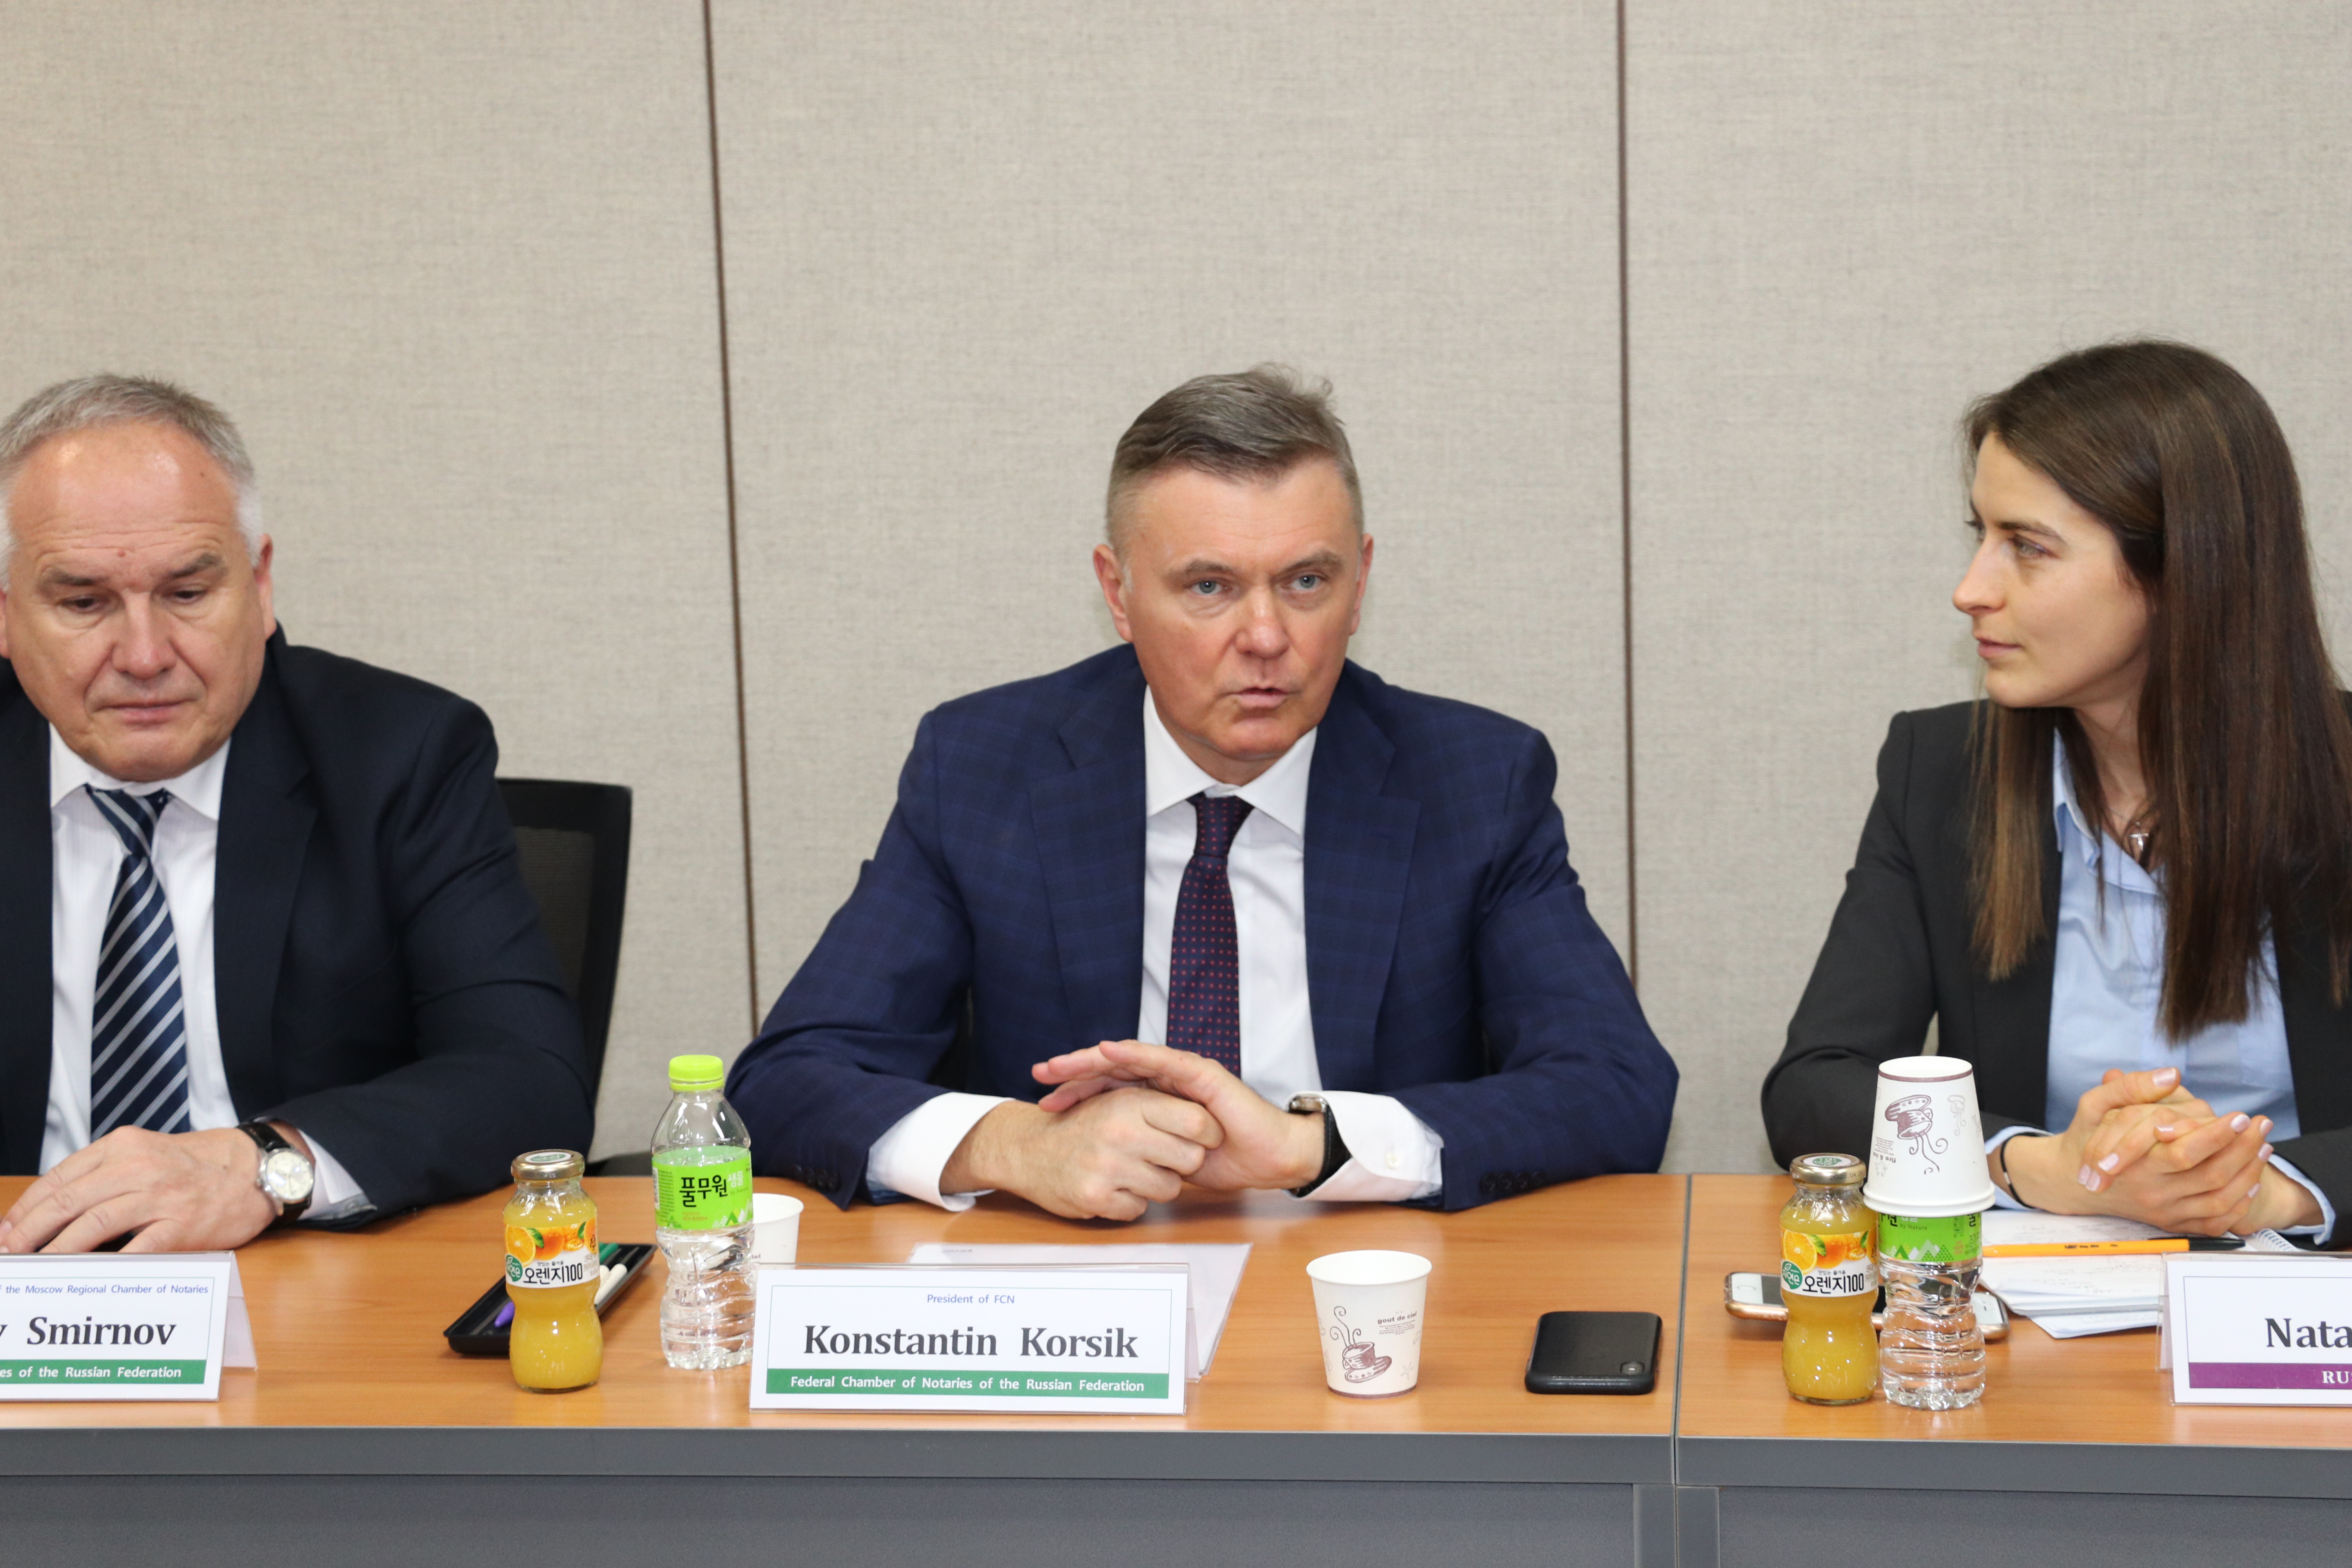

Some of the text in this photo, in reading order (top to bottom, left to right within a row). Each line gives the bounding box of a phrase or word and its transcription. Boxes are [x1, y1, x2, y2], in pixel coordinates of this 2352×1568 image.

[679, 1175, 728, 1207] 풀무원
[523, 1263, 583, 1285] 오렌지100
[1802, 1273, 1864, 1294] 오렌지100
[6, 1285, 20, 1293] the
[25, 1285, 63, 1294] Moscow
[67, 1285, 107, 1296] Regional
[111, 1285, 152, 1293] Chamber
[156, 1285, 167, 1293] of
[171, 1285, 208, 1293] Notaries
[927, 1294, 1014, 1304] President of FCN
[27, 1316, 177, 1345] Smirnov
[804, 1325, 1138, 1357] Konstantin Korsik
[19, 1366, 33, 1377] of
[39, 1366, 59, 1377] the
[65, 1366, 111, 1377] Russian
[118, 1366, 181, 1378] Federation
[791, 1376, 1144, 1392] Federal Chamber of Notaries of the Russian Federation
